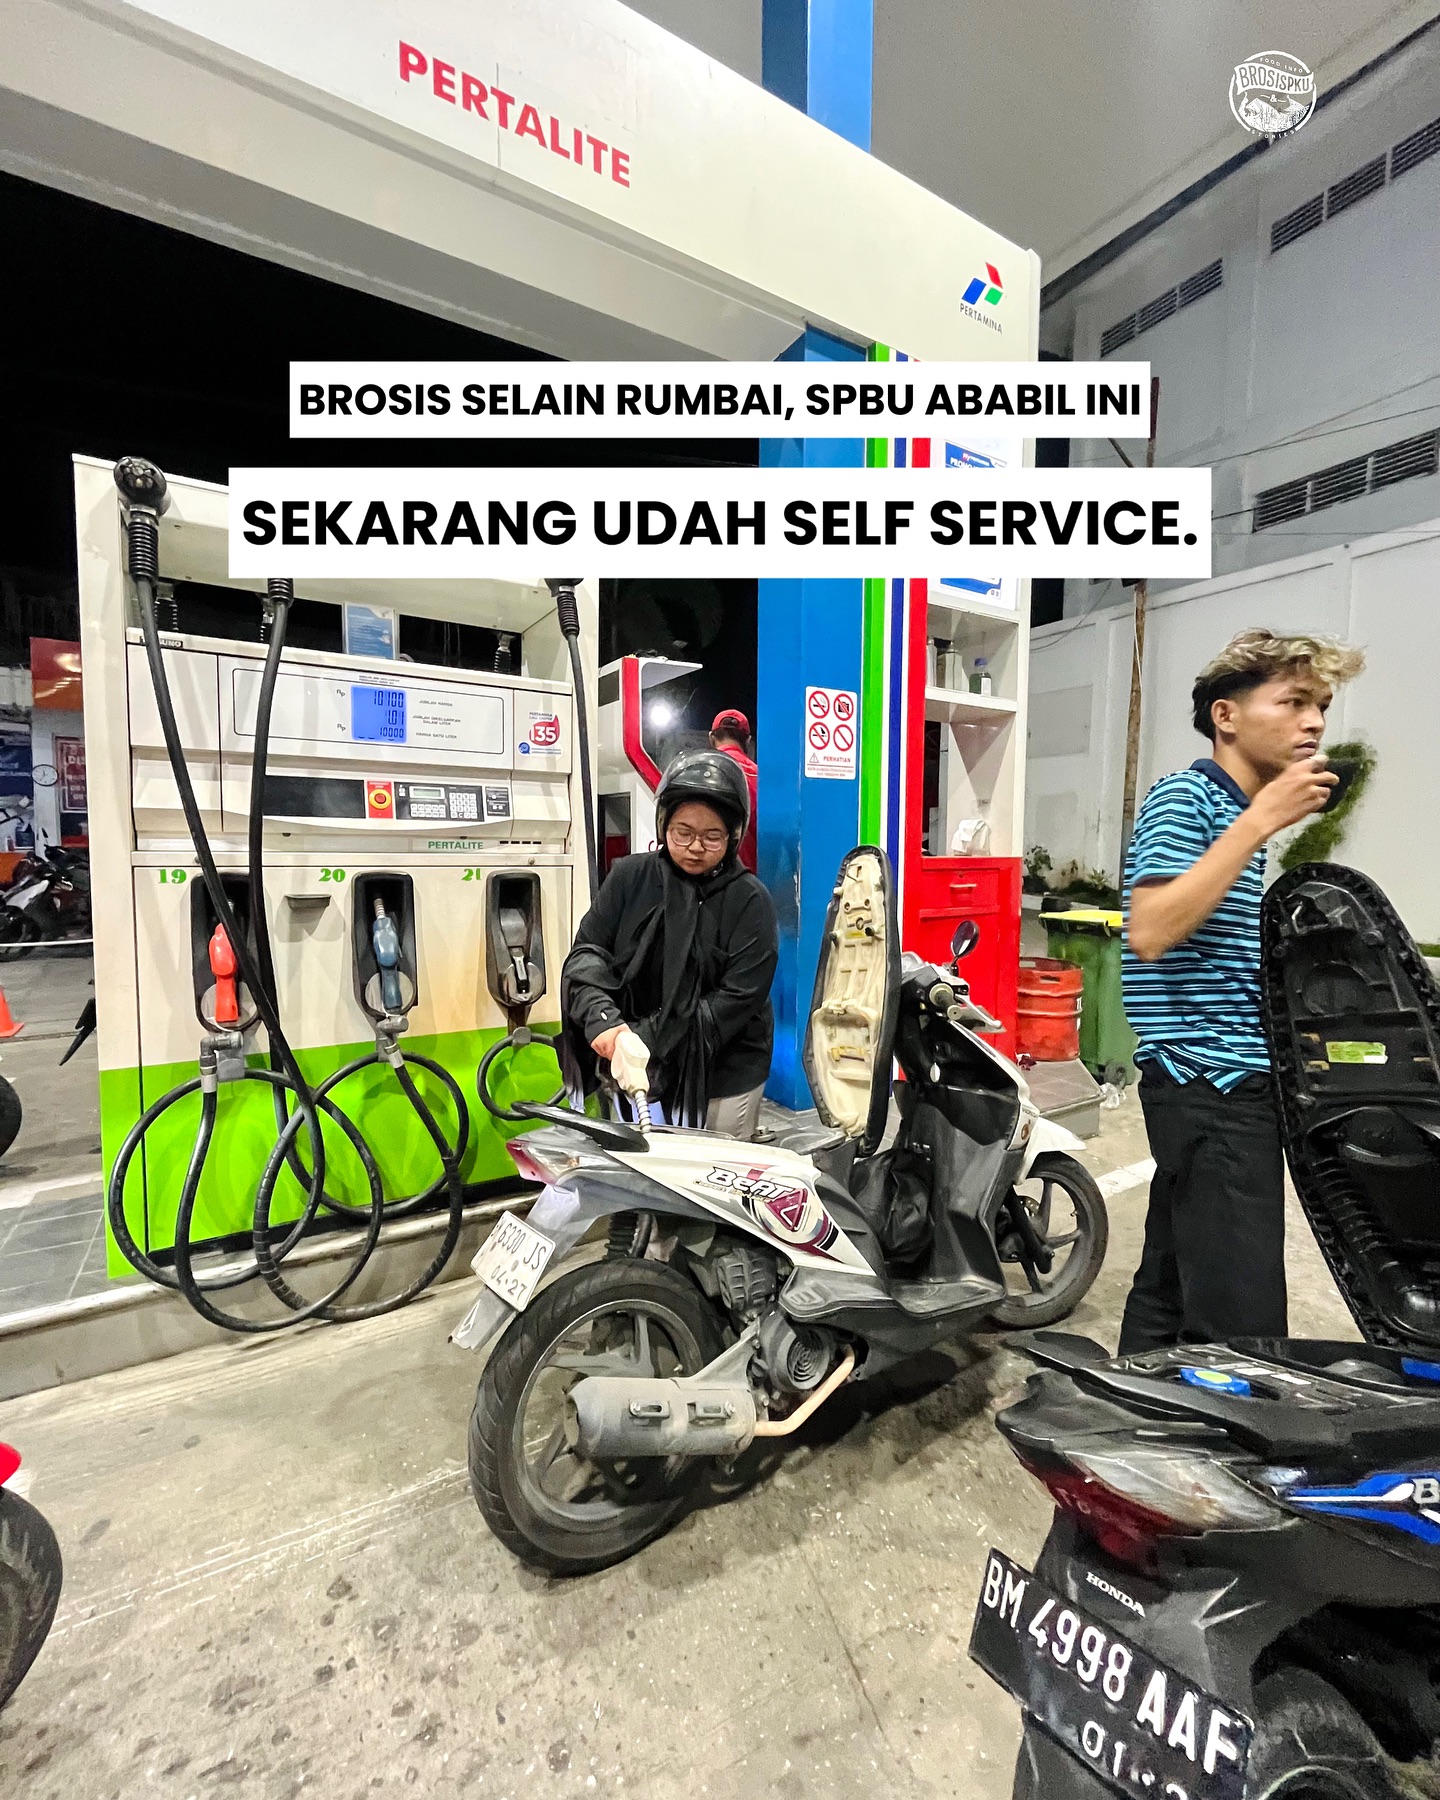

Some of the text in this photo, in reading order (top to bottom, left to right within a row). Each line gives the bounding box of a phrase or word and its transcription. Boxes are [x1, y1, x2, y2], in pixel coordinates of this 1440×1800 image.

[399, 40, 631, 188] PERTALITE
[959, 302, 1003, 335] PERTAMINA
[530, 726, 557, 743] 135
[428, 841, 484, 850] PERTALITE
[159, 869, 187, 884] 19
[319, 868, 346, 883] 20
[461, 868, 481, 881] 21
[523, 1242, 547, 1270] JS
[1086, 1571, 1146, 1618] HONDA
[983, 1557, 1238, 1775] BM 4998 AAF
